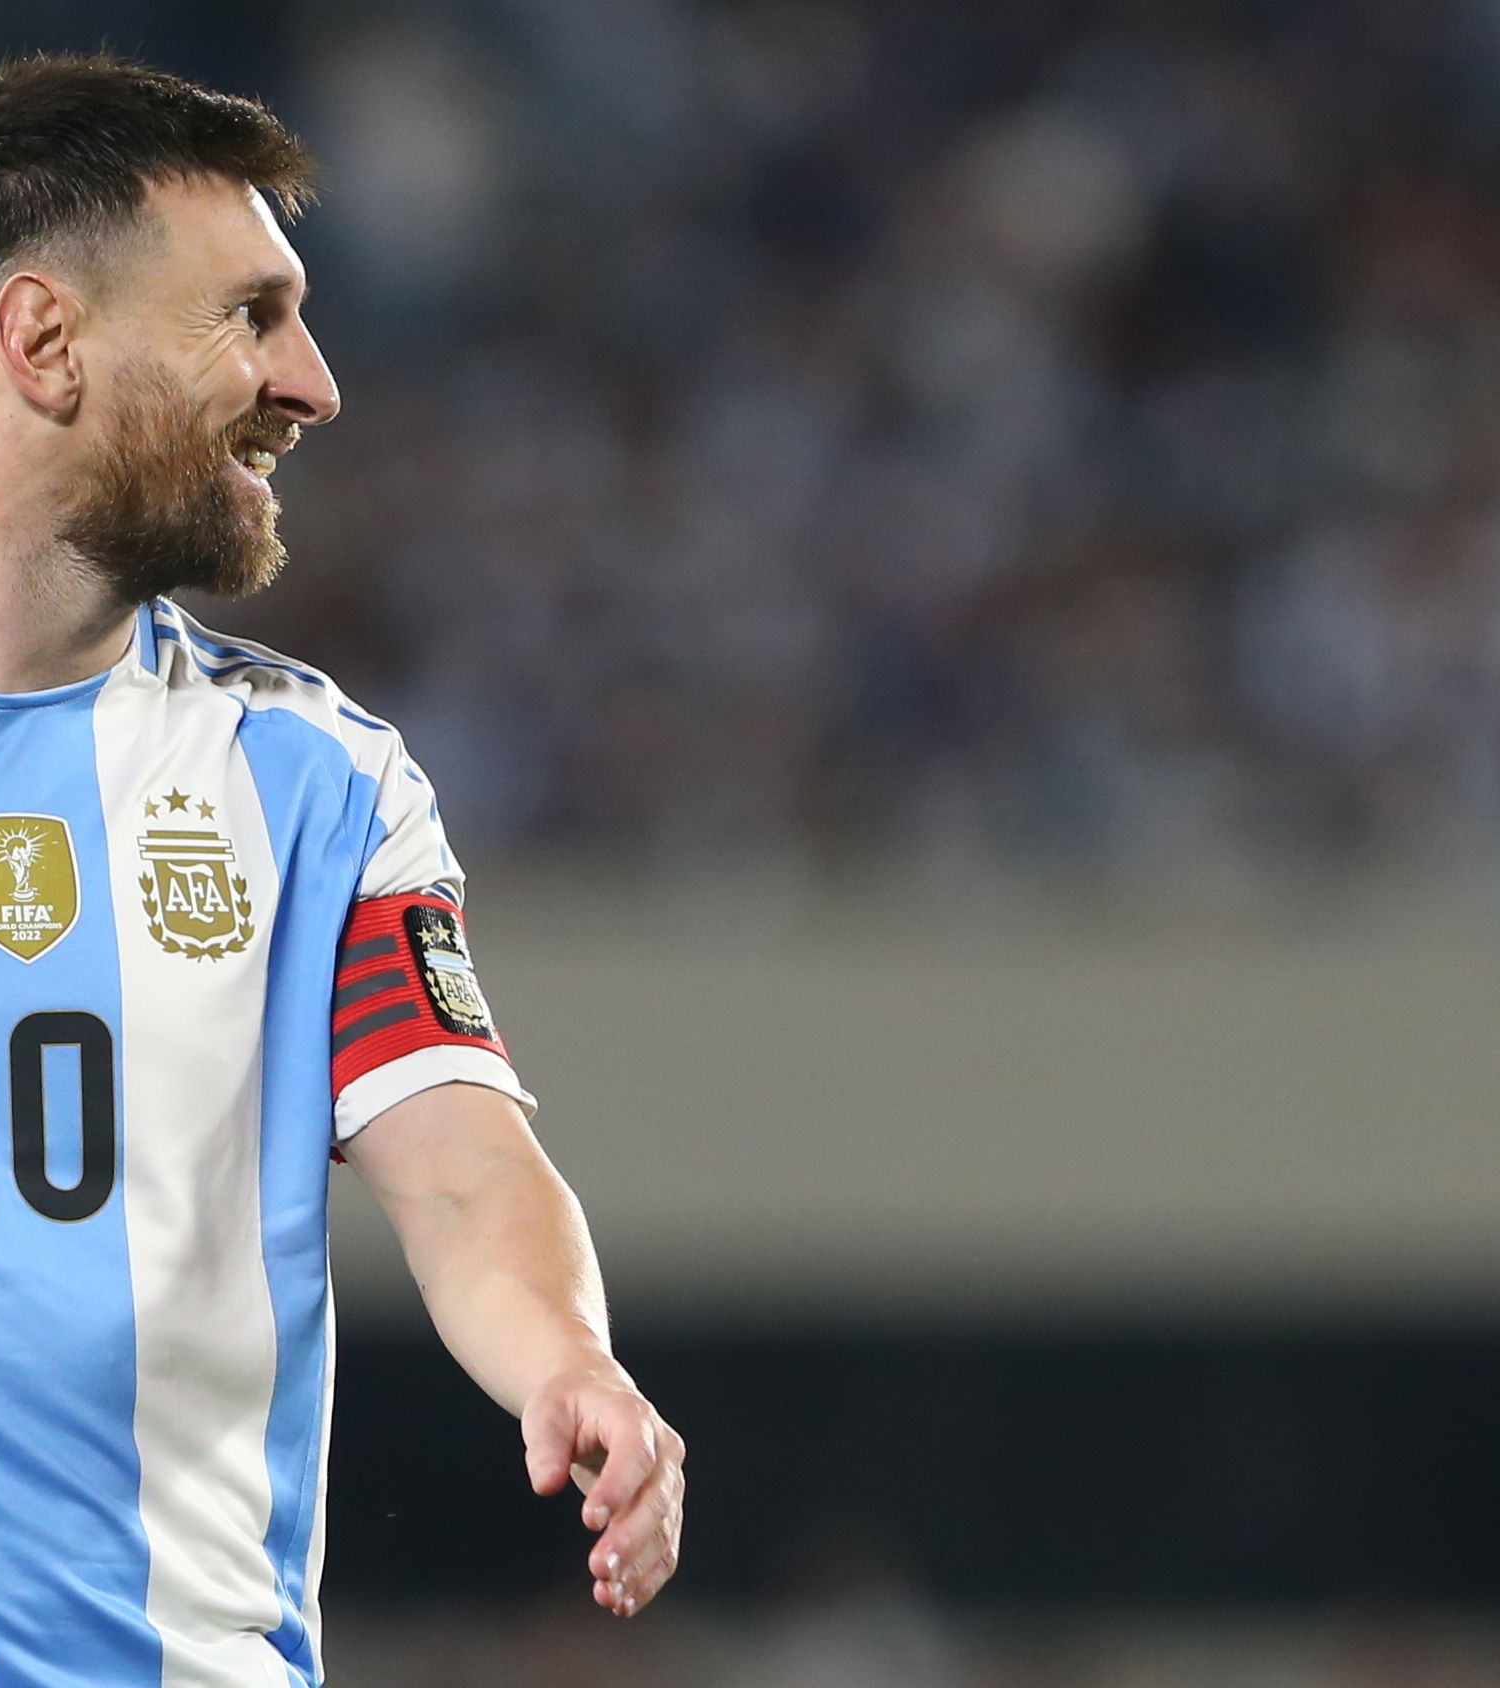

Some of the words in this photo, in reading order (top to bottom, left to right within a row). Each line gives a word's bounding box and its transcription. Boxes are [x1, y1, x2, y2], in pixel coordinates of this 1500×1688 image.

[165, 862, 229, 924] AFA
[1, 904, 52, 923] FIFA
[18, 921, 63, 930] CHAMPIONS
[11, 930, 42, 942] 2022
